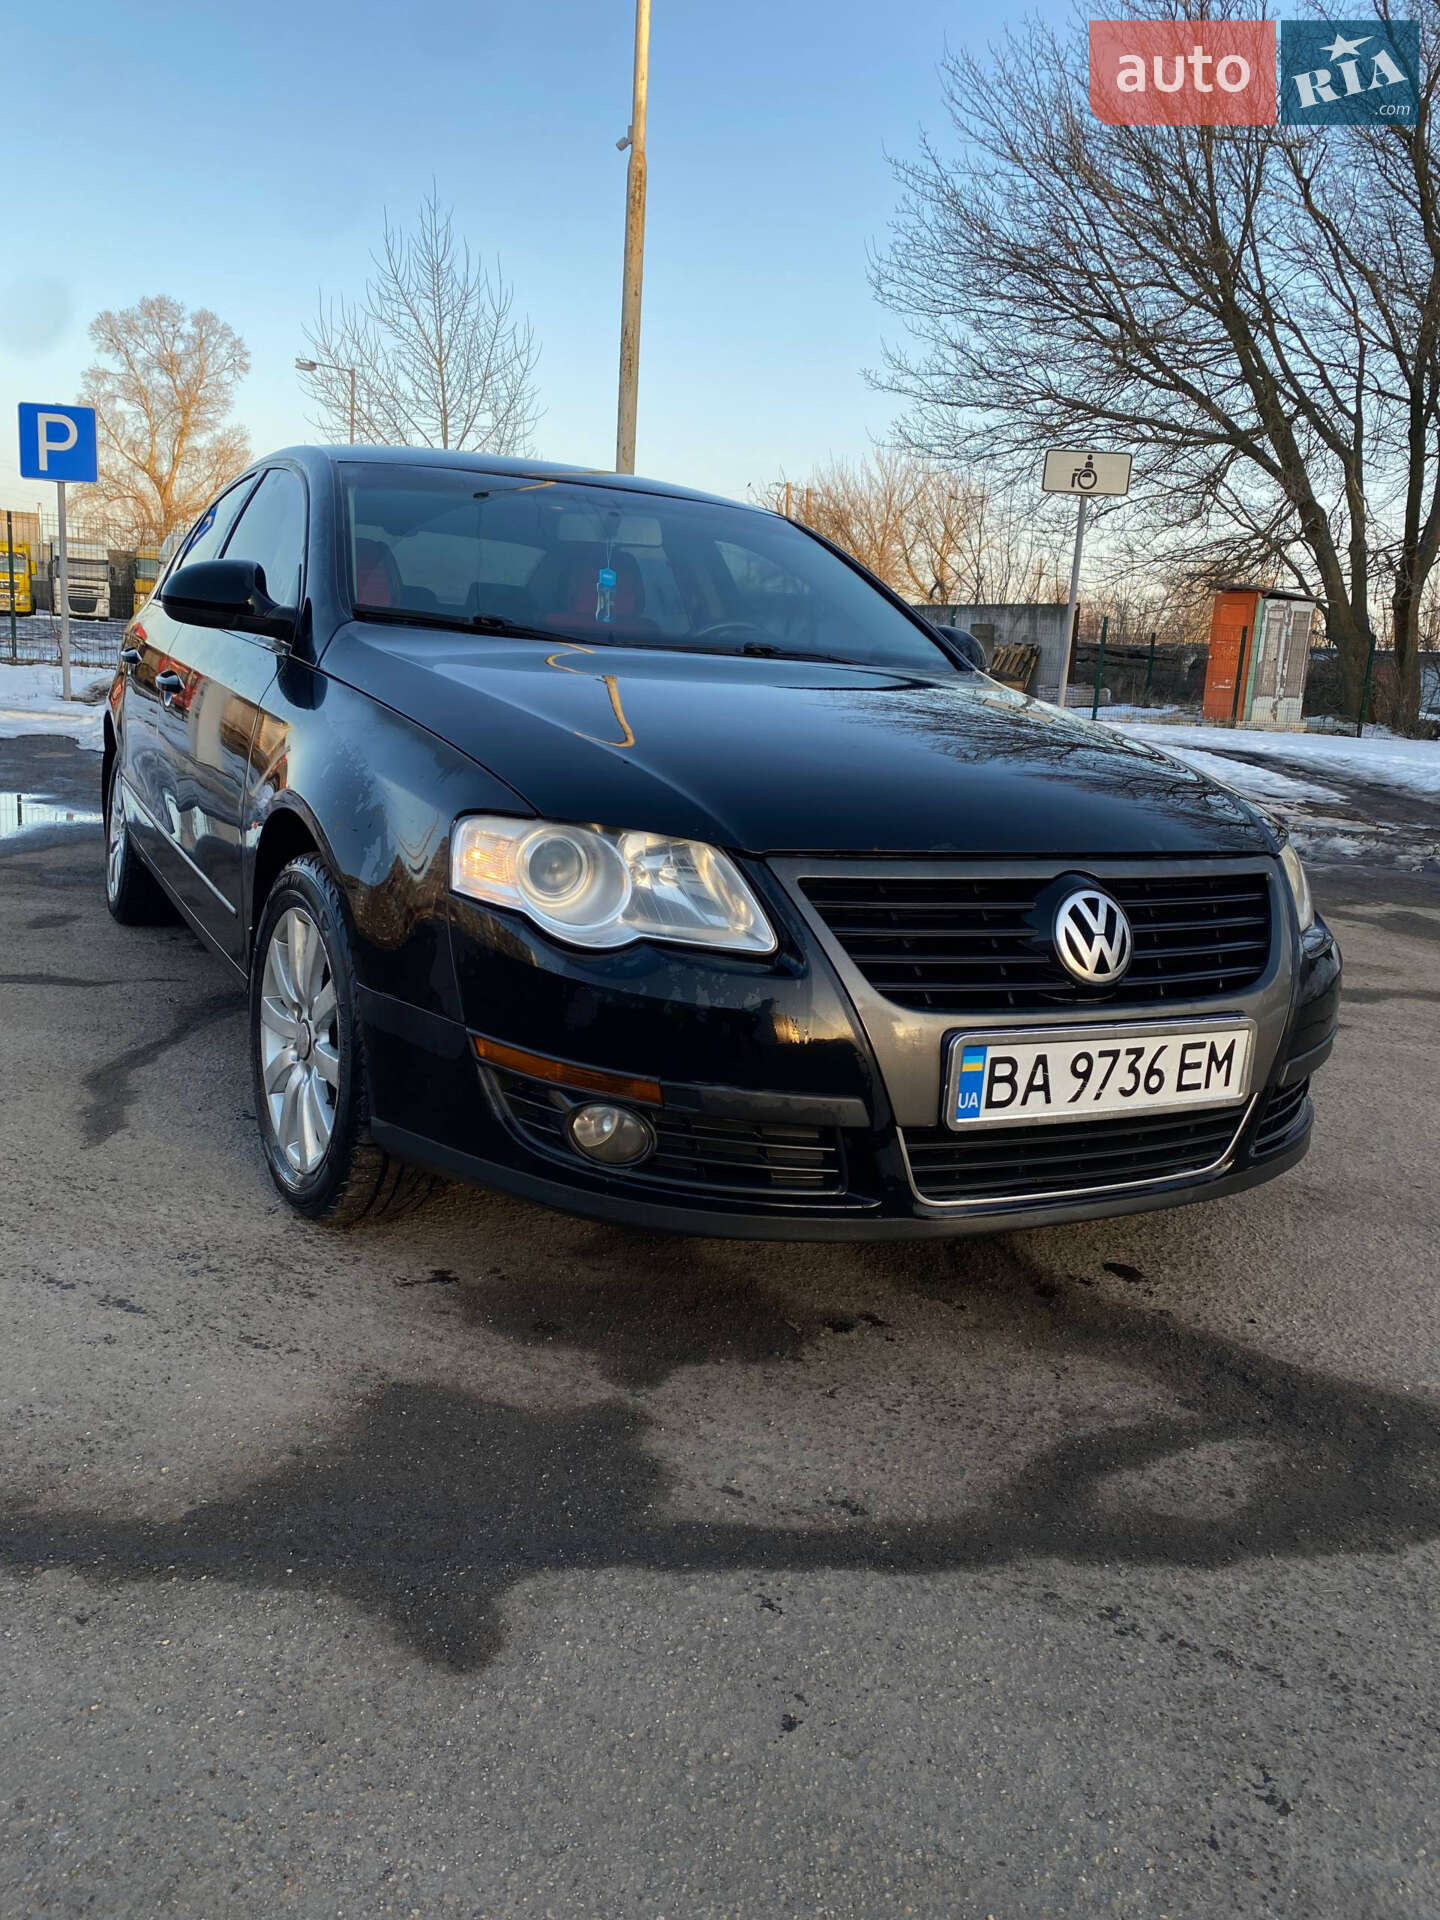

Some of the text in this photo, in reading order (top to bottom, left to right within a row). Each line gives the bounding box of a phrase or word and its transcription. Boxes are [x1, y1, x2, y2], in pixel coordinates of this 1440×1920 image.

[37, 412, 78, 471] P
[1056, 890, 1131, 982] VW
[958, 1092, 979, 1109] UA
[985, 1038, 1236, 1109] BA 9736 EM
